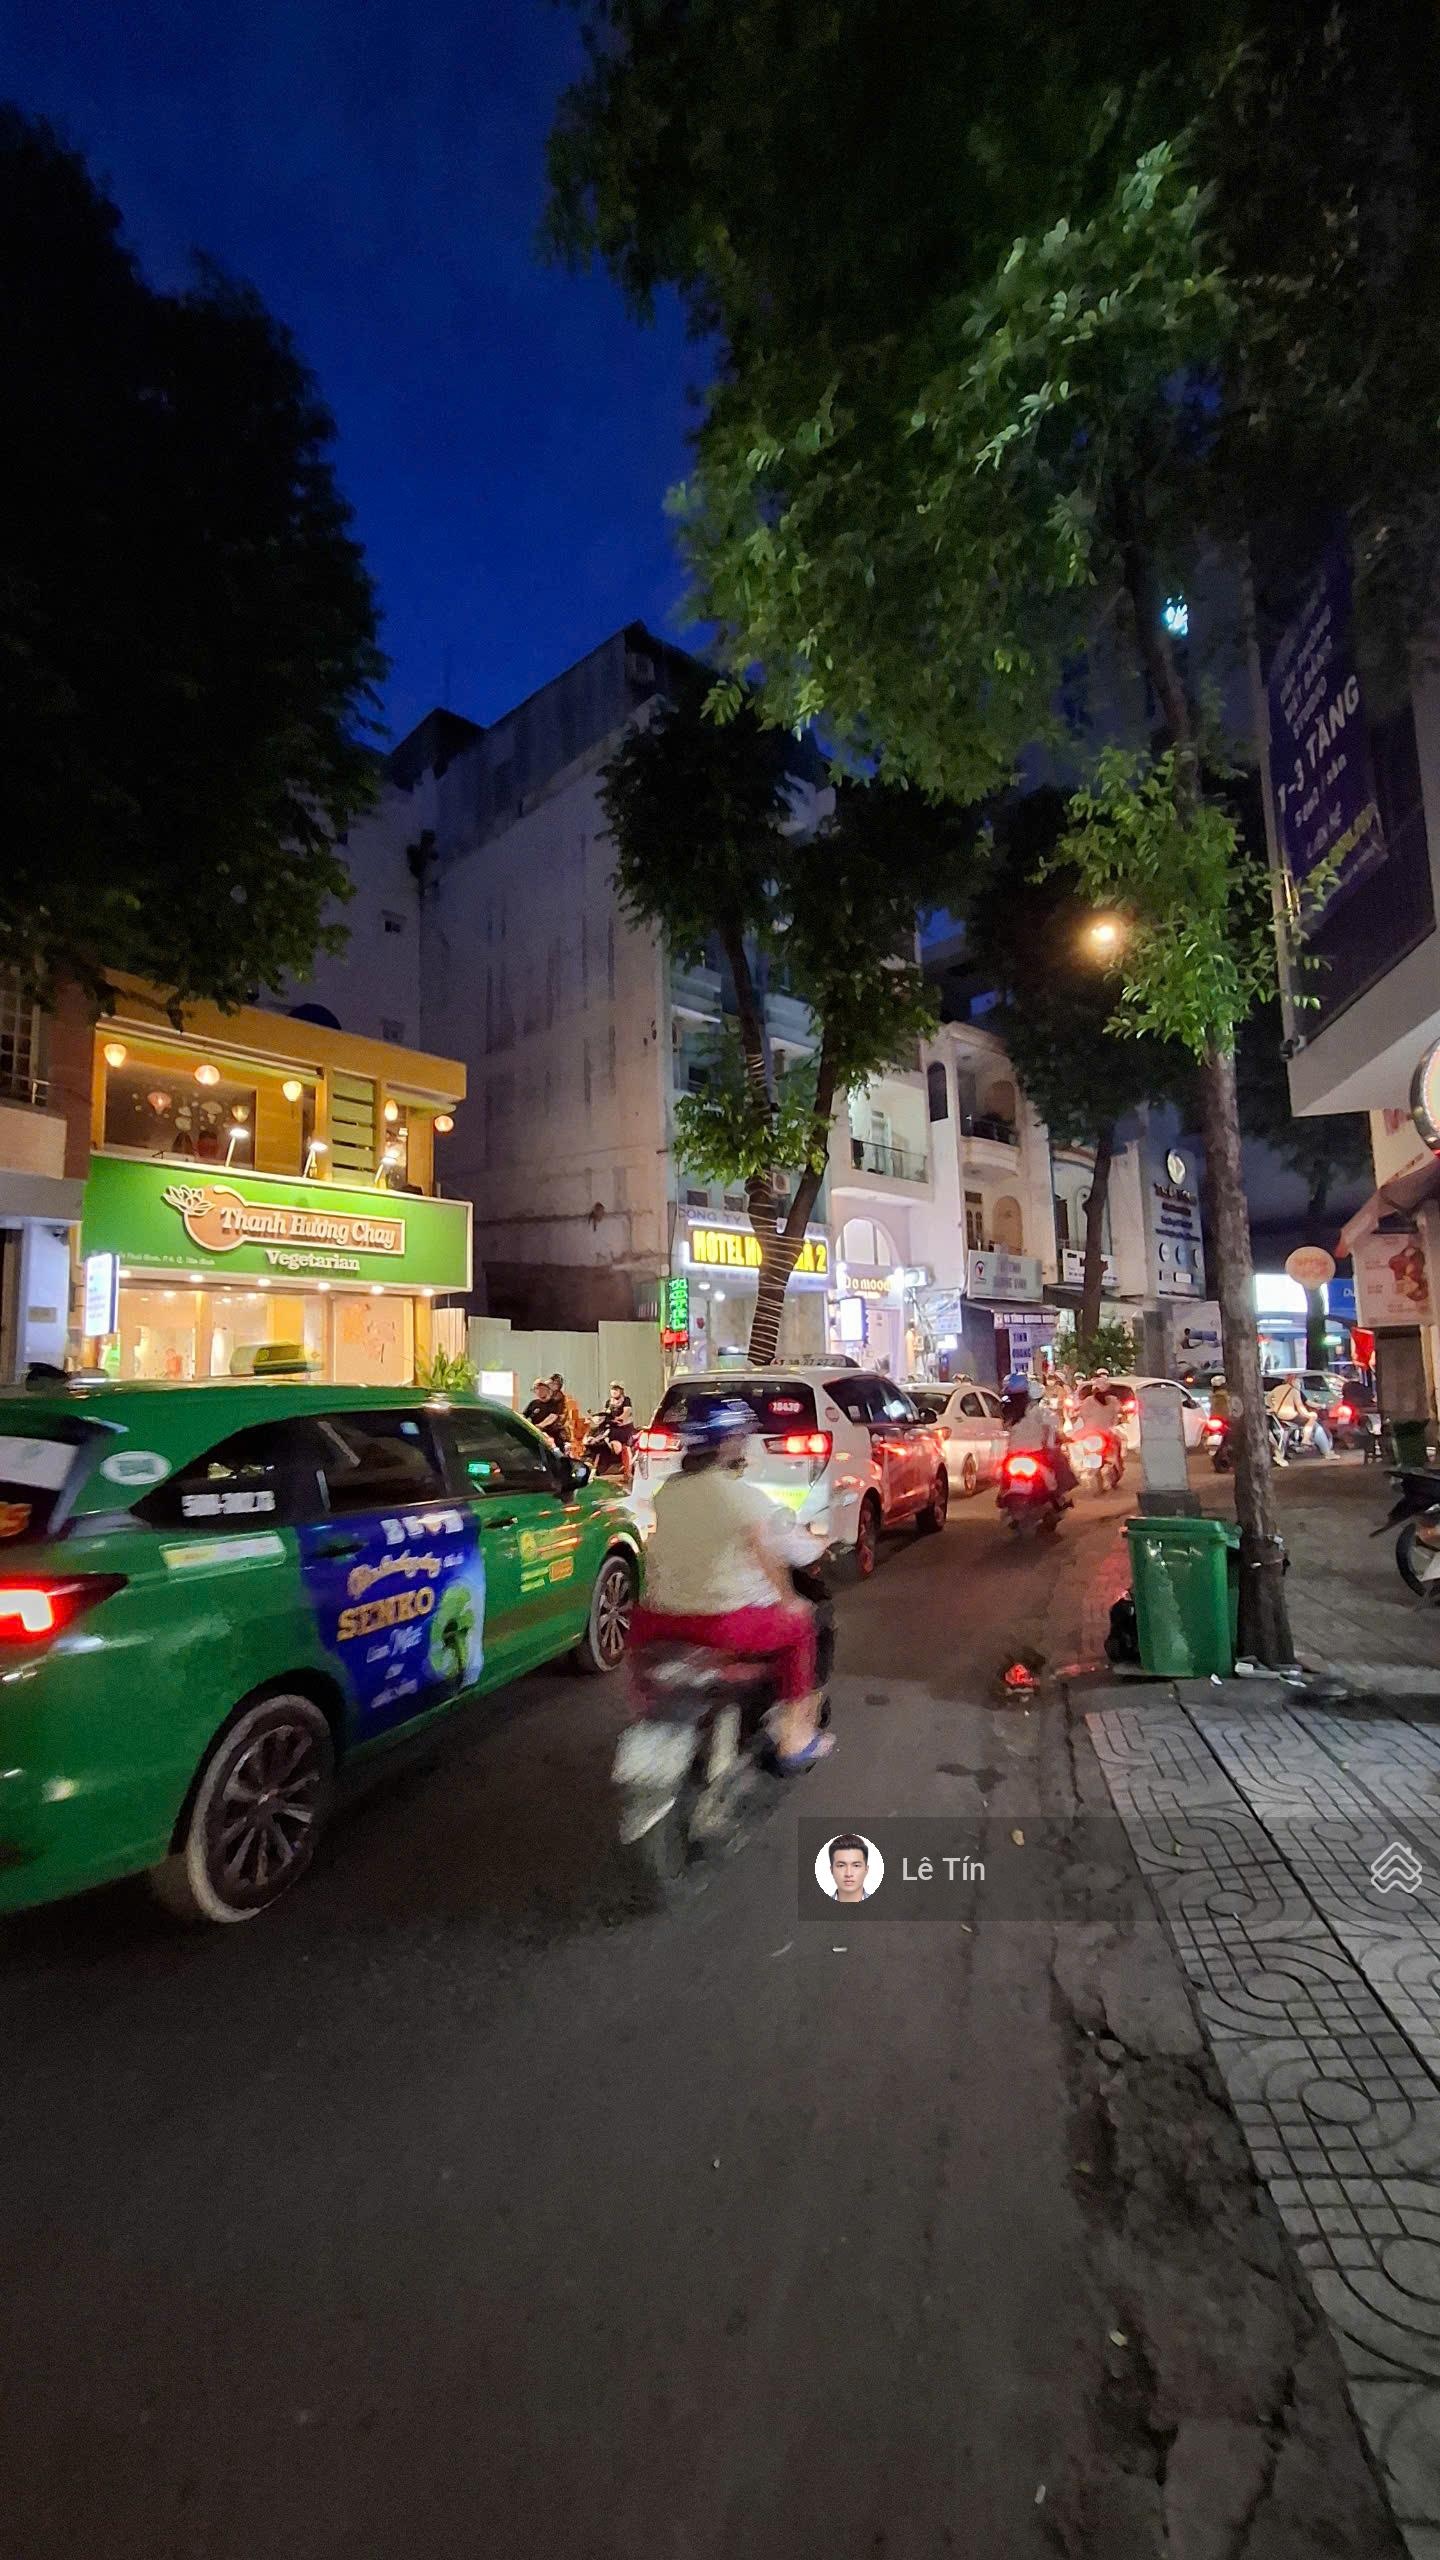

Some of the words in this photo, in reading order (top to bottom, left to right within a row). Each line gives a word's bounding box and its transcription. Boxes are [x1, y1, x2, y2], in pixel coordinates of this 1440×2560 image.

[220, 1206, 286, 1235] Thanh
[351, 1221, 397, 1250] Chay
[265, 1249, 361, 1271] Vegetarian
[693, 1230, 746, 1266] HOTEL
[815, 1244, 827, 1272] 2
[336, 1586, 435, 1642] SENKO
